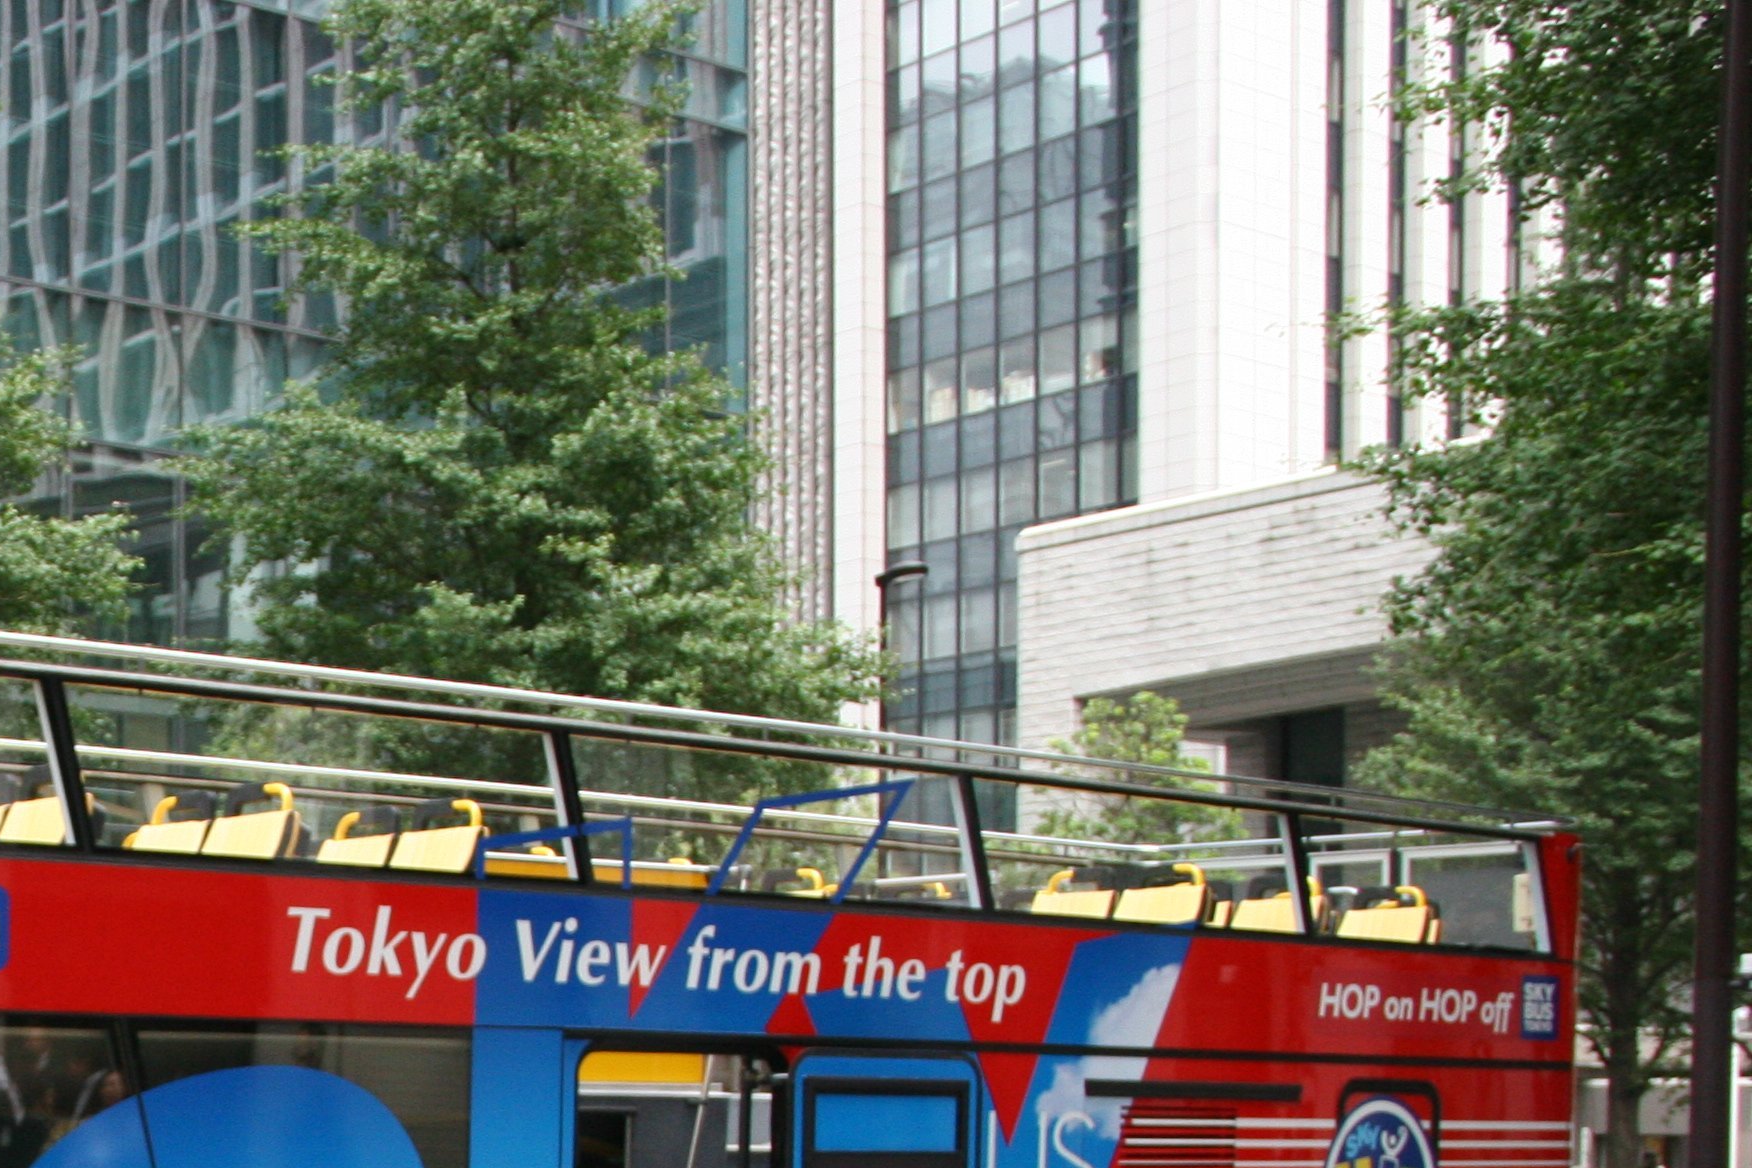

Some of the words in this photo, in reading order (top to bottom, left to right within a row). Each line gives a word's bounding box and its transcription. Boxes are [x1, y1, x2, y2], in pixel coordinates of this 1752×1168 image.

[286, 905, 487, 999] Tokyo
[515, 916, 666, 987] View
[686, 924, 822, 996] from
[842, 935, 926, 1000] the
[945, 950, 1026, 1023] top
[1318, 981, 1381, 1019] HOP
[1383, 996, 1414, 1021] on
[1418, 987, 1478, 1023] HOP
[1480, 991, 1515, 1033] off
[1524, 982, 1555, 1001] SKY
[1345, 1120, 1380, 1158] SKY
